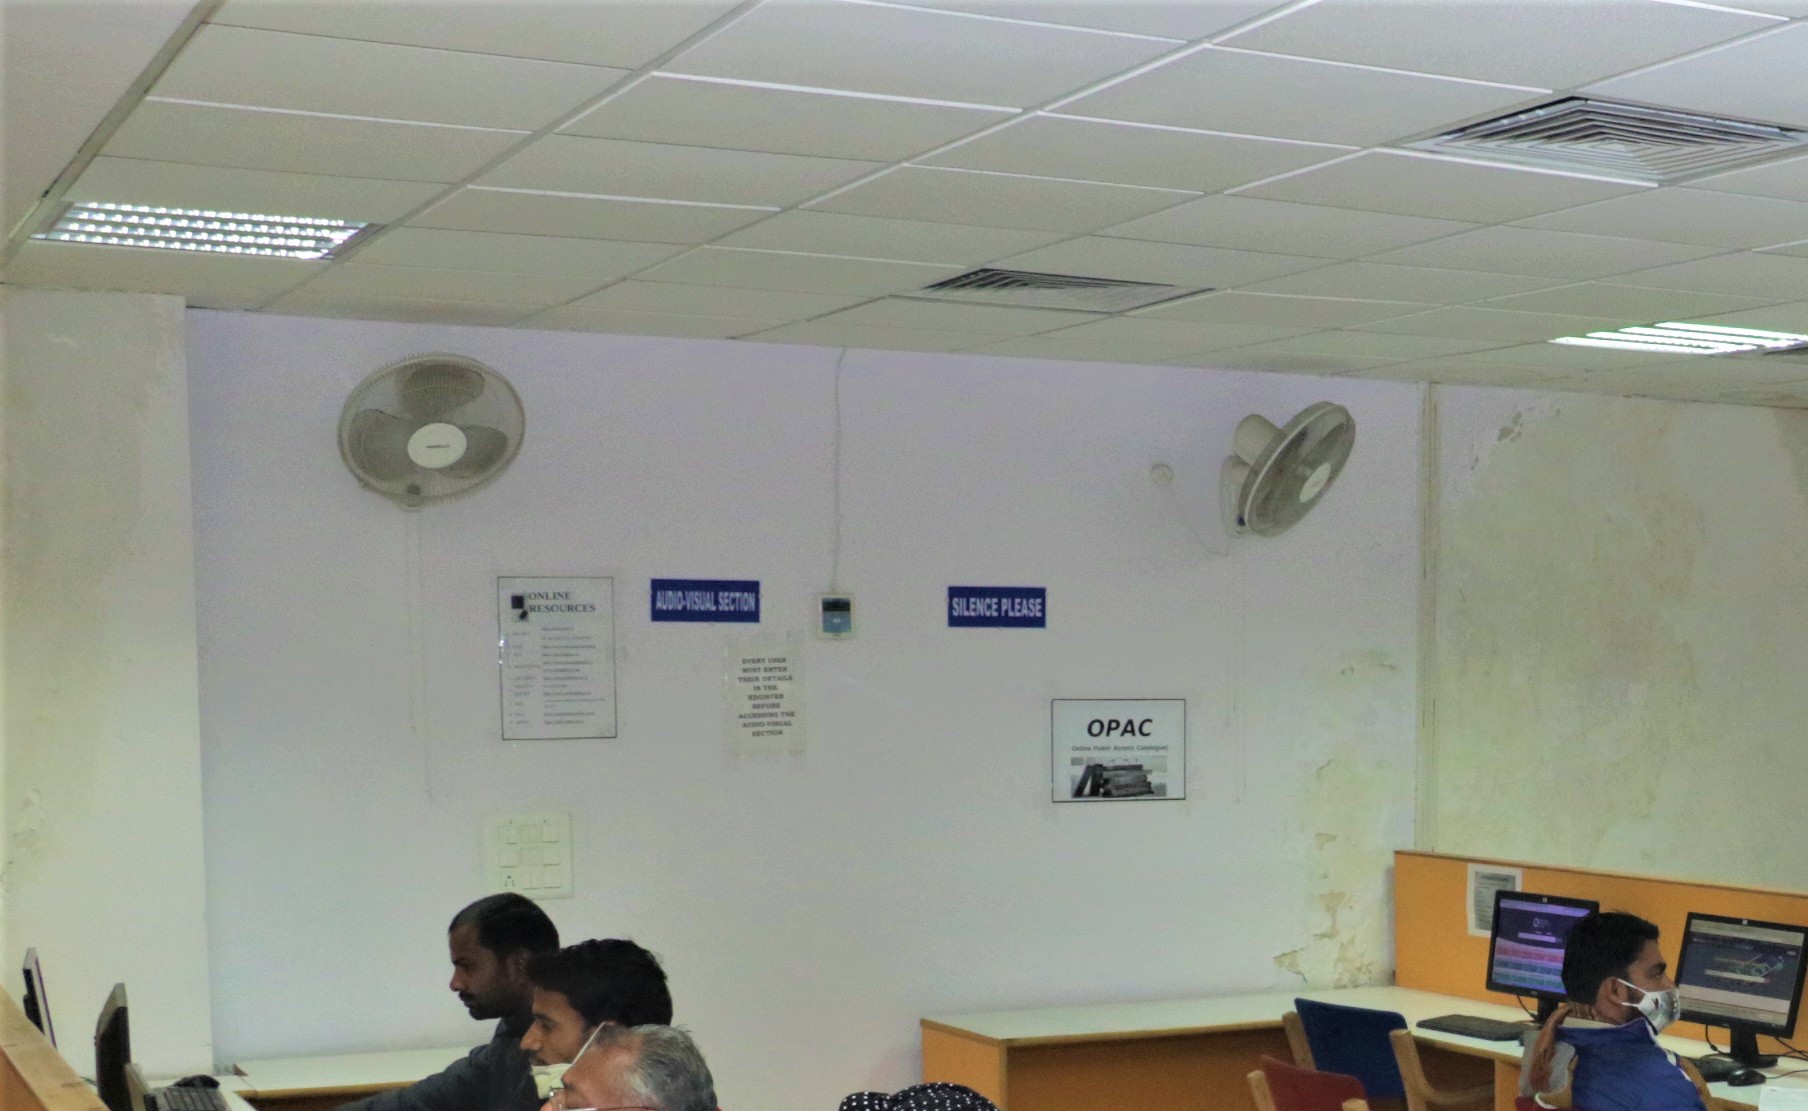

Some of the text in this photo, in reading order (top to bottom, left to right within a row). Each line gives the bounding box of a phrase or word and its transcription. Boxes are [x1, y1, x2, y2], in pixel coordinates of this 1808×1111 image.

[528, 591, 571, 600] ONLINE
[655, 590, 755, 612] AUDIO-VISUAL SECTION
[529, 604, 596, 613] RESOURCES
[952, 597, 1042, 617] SILENCE PLEASE
[1087, 719, 1153, 737] OPAC
